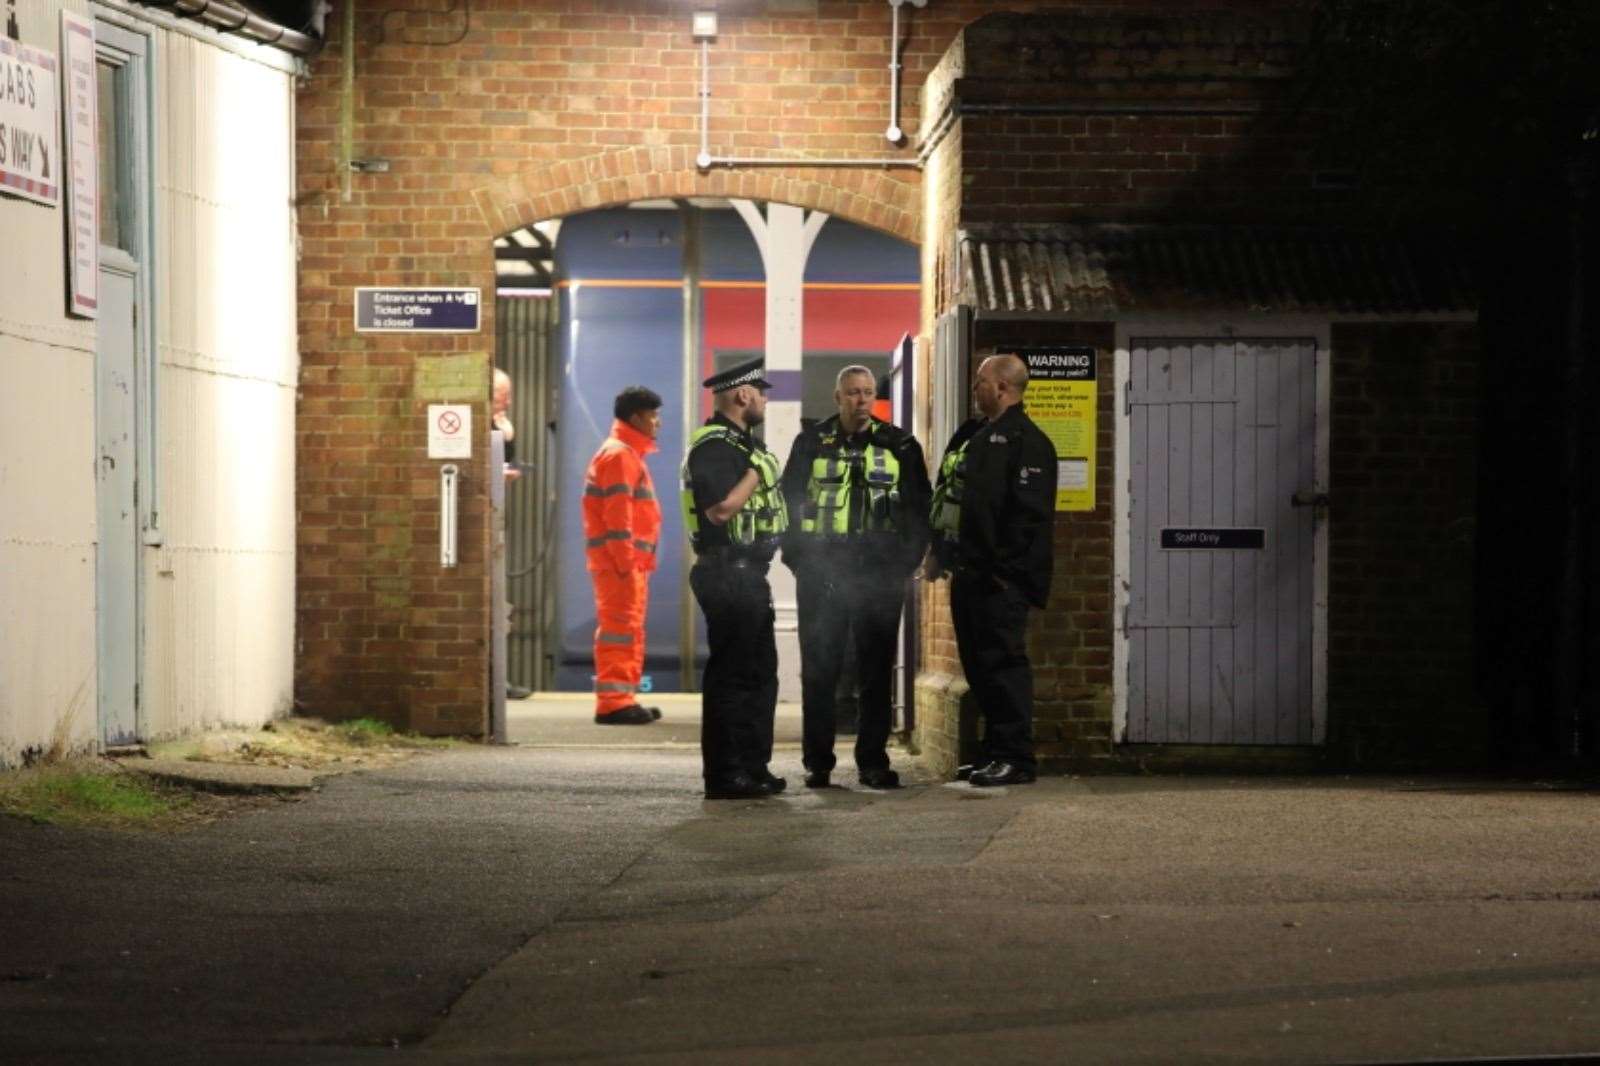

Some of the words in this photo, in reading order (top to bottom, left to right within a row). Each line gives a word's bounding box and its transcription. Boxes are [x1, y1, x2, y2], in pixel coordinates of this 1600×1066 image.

[11, 126, 35, 171] WAY
[374, 292, 415, 302] Entrance
[417, 293, 443, 302] when
[374, 305, 402, 314] Ticket
[404, 305, 432, 315] Office
[373, 318, 381, 327] is
[383, 318, 414, 327] closed
[1028, 355, 1090, 366] WARNING
[1066, 369, 1088, 377] paid?
[1175, 532, 1197, 543] Staff
[1199, 532, 1220, 544] Only
